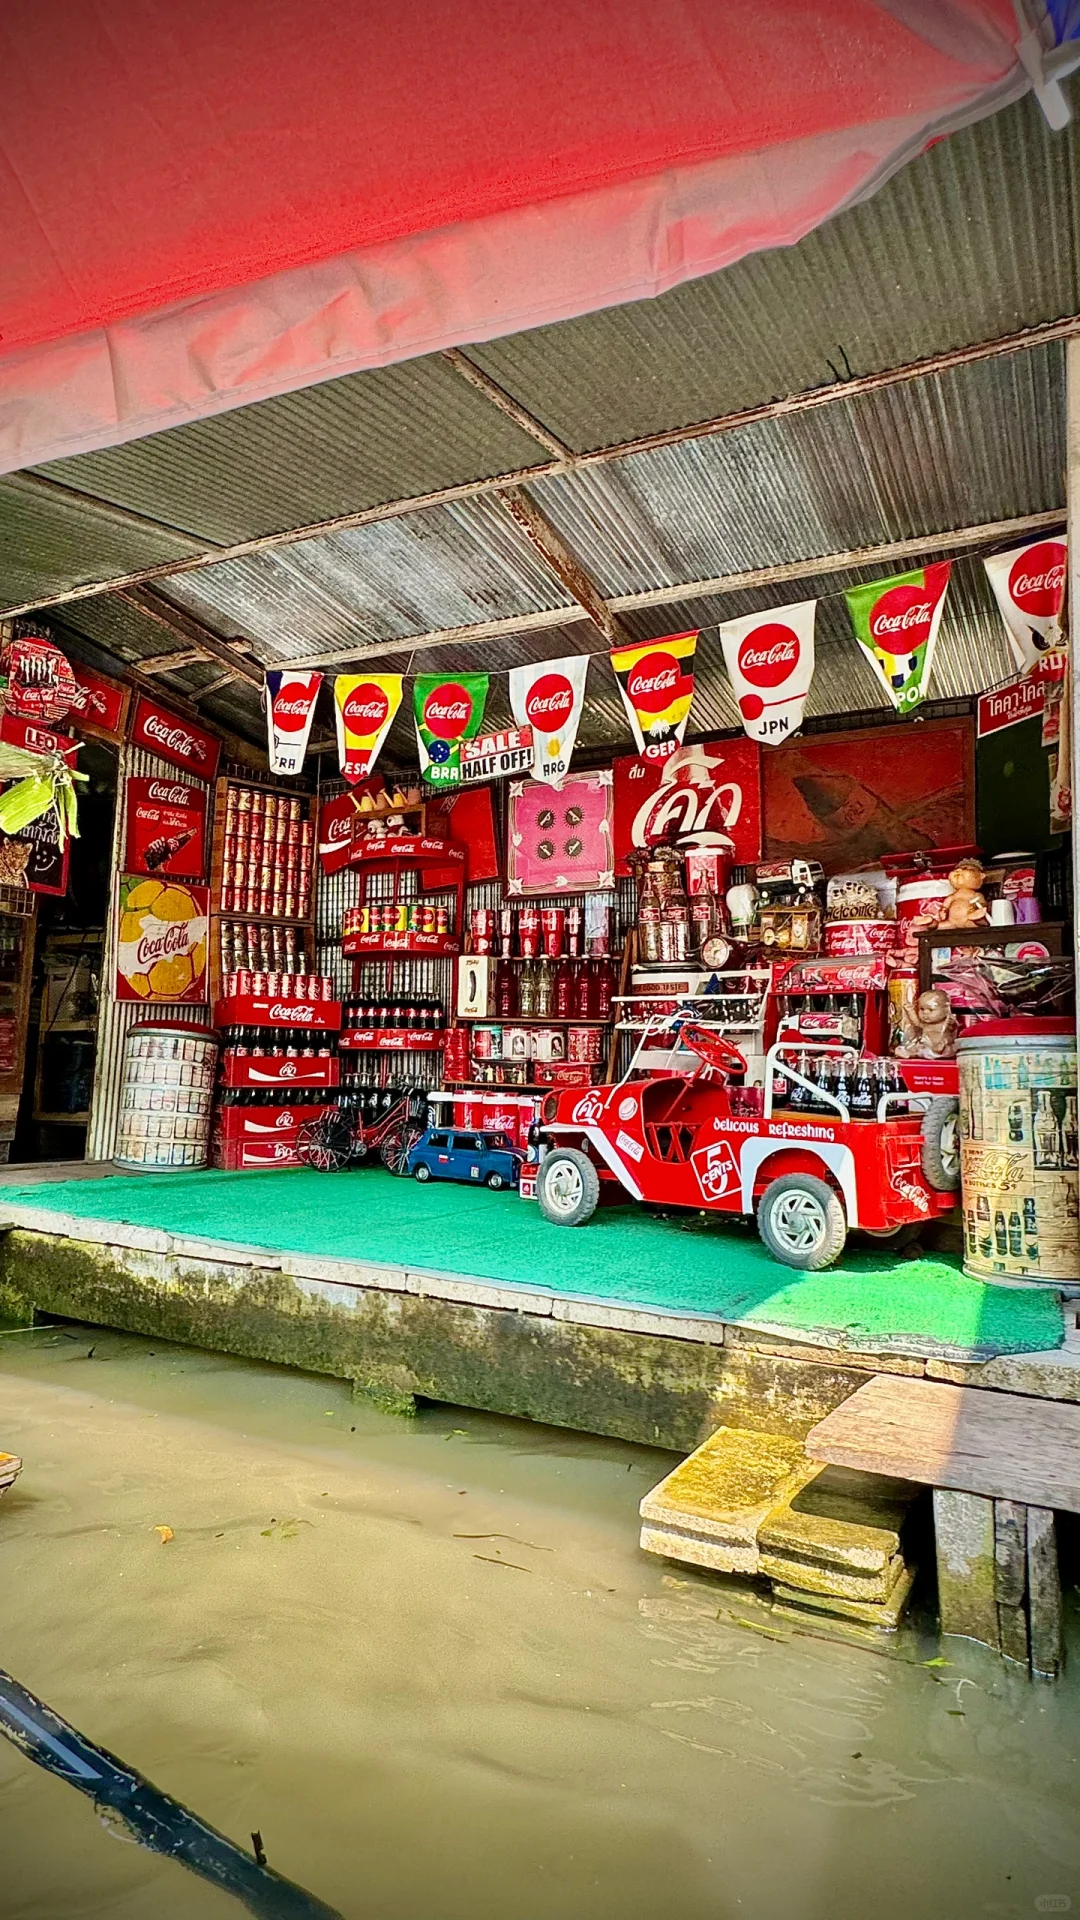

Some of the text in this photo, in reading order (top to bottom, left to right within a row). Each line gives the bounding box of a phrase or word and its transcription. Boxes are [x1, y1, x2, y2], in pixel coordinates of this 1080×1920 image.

[1013, 566, 1065, 598] Coca-Co
[874, 603, 930, 635] Coca-Cola
[740, 641, 795, 669] Coca-Cola
[629, 667, 676, 694] Coca-Cola
[344, 699, 383, 718] Coca-Cola
[426, 701, 467, 720] Coca-Cola
[527, 685, 572, 715] Coca-Cola
[986, 680, 1045, 717] โคคา-โคล
[26, 729, 56, 748] LEO
[144, 715, 194, 757] Coca-Cola
[758, 717, 789, 736] JPN
[464, 730, 521, 759] SALE
[646, 740, 676, 759] GER
[431, 766, 459, 780] BRA
[462, 748, 532, 780] HALF OFF!
[543, 759, 565, 777] ARG
[149, 781, 190, 805] Coca-Cola
[137, 921, 189, 964] Coca-Cola
[269, 1003, 315, 1022] Coca-Cola
[702, 1160, 733, 1184] CENTS
[889, 1169, 931, 1213] Coca-Cola
